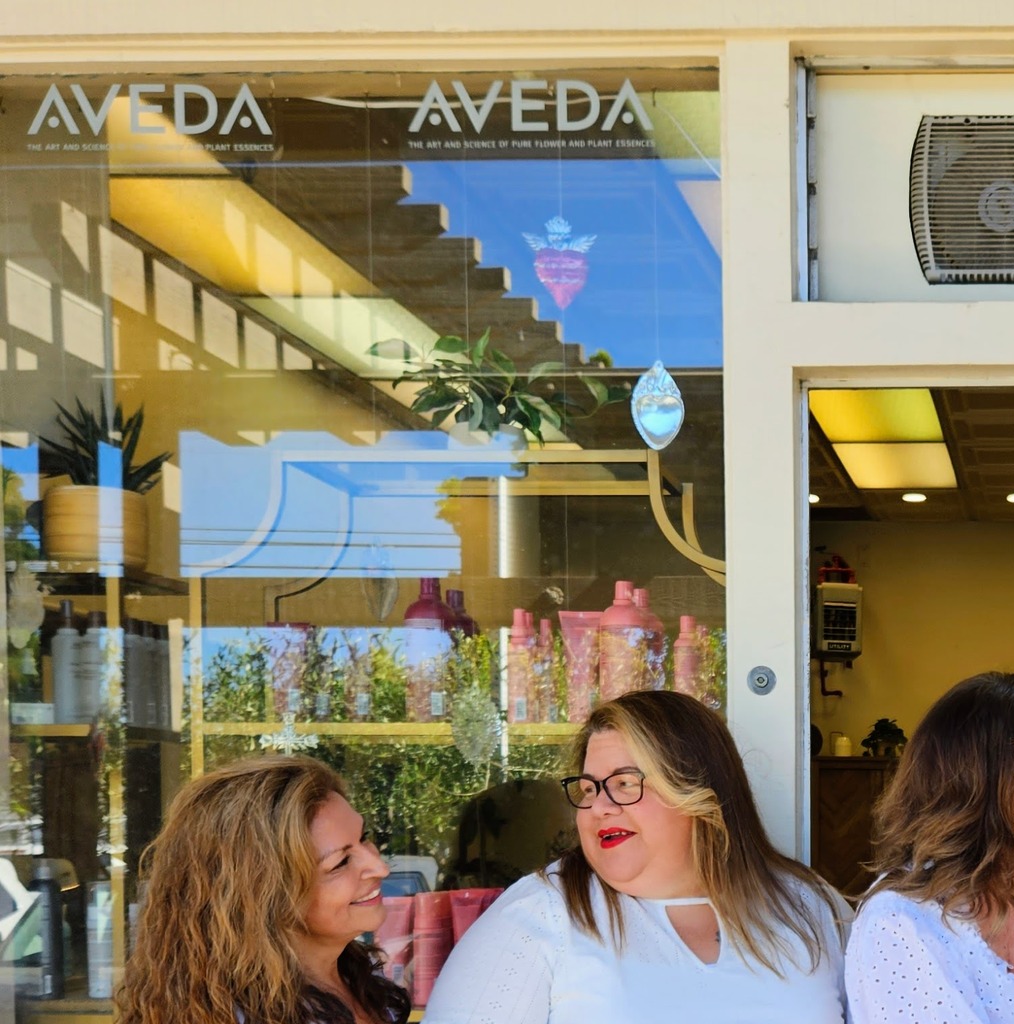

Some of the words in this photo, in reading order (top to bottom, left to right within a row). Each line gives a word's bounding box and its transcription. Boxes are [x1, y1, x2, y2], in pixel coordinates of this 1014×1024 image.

[27, 83, 273, 137] AVEDA
[408, 78, 654, 134] AVEDA
[27, 143, 42, 152] THE
[45, 143, 60, 152] ART
[63, 143, 80, 152] AND
[206, 143, 231, 152] PLANT
[233, 143, 274, 152] ESSENCES
[408, 140, 423, 149] THE
[426, 140, 441, 149] ART
[444, 140, 461, 149] AND
[464, 140, 496, 149] SCIENCE
[512, 139, 532, 148] PURE
[535, 139, 566, 148] FLOWER
[569, 139, 585, 148] AND
[588, 139, 612, 148] PLANT
[616, 139, 656, 148] ESSENCES
